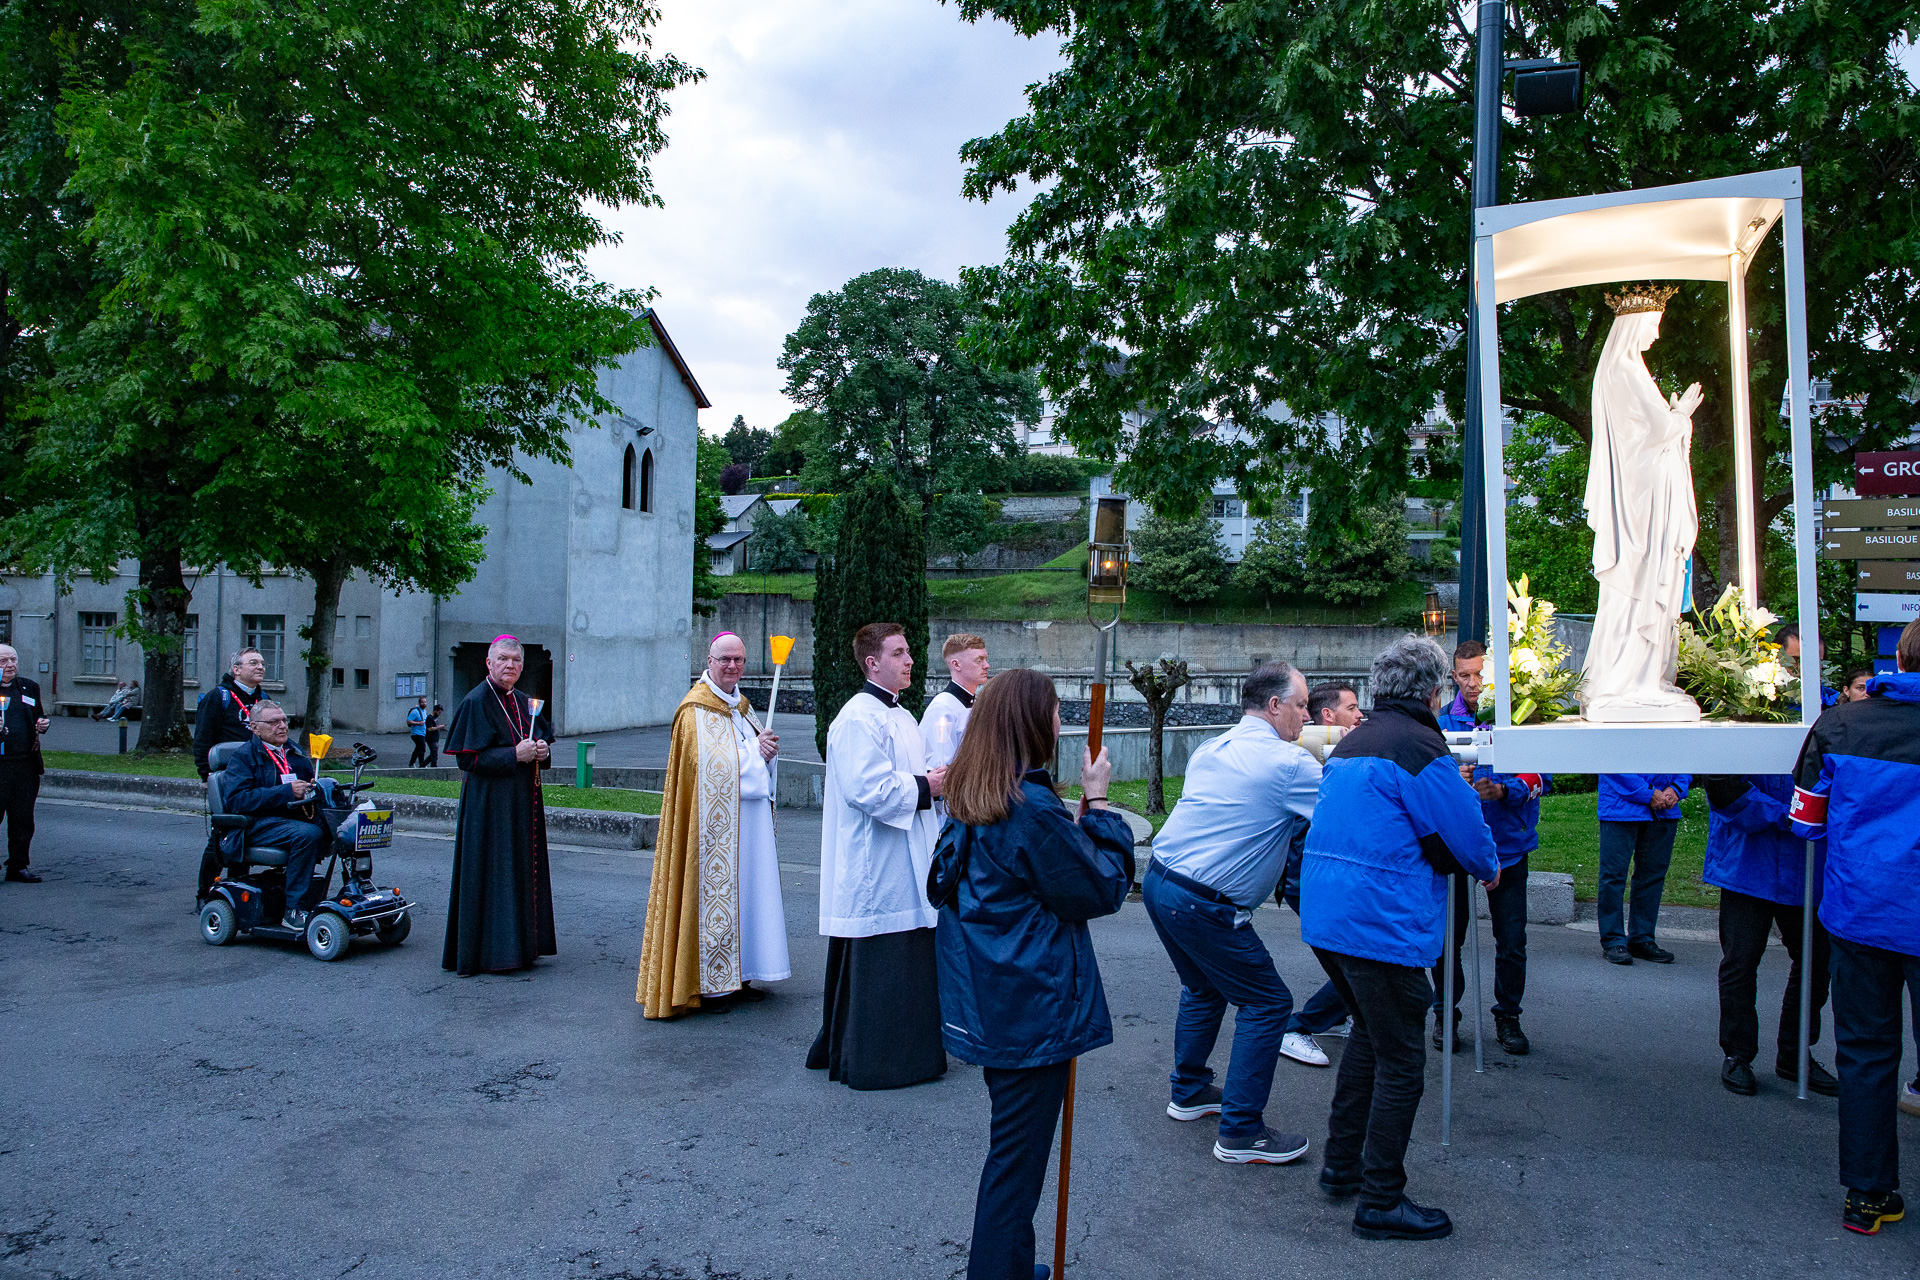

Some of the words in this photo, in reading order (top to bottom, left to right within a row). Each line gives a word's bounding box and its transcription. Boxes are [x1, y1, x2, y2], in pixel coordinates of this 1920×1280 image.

[1887, 508, 1920, 517] BASILI
[1865, 535, 1918, 544] BASILIQUE
[359, 825, 382, 835] HIRE
